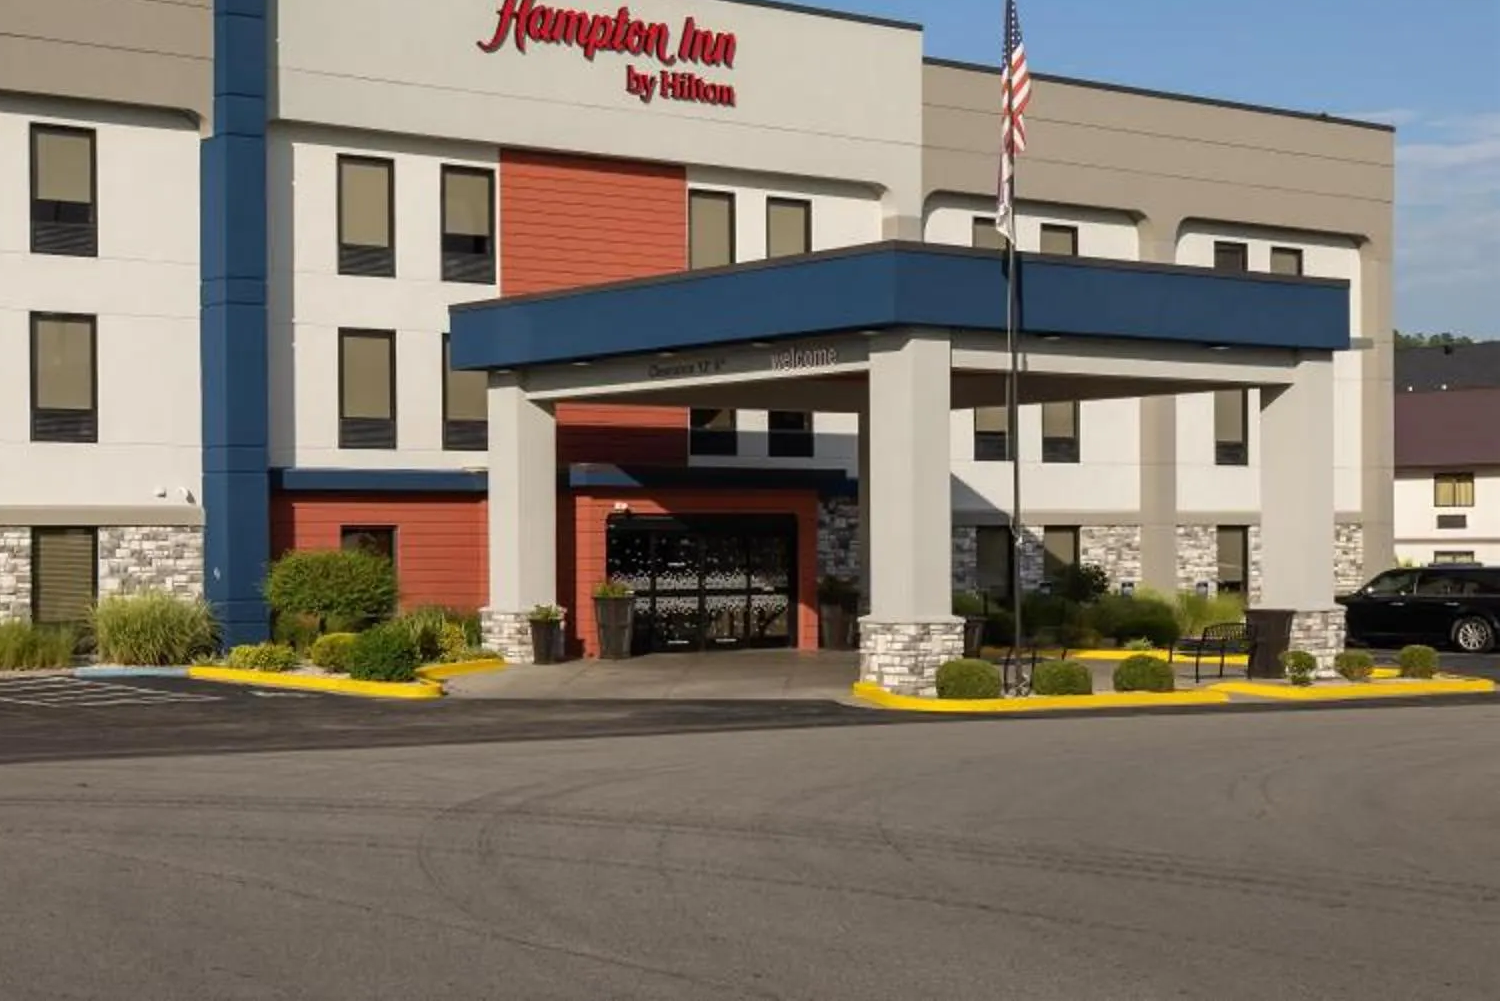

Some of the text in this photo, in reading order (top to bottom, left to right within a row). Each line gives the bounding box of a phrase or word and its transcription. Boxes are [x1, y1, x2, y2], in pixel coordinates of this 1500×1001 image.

[678, 16, 736, 69] Inn
[626, 64, 736, 108] by Hilton
[770, 347, 837, 373] welcome
